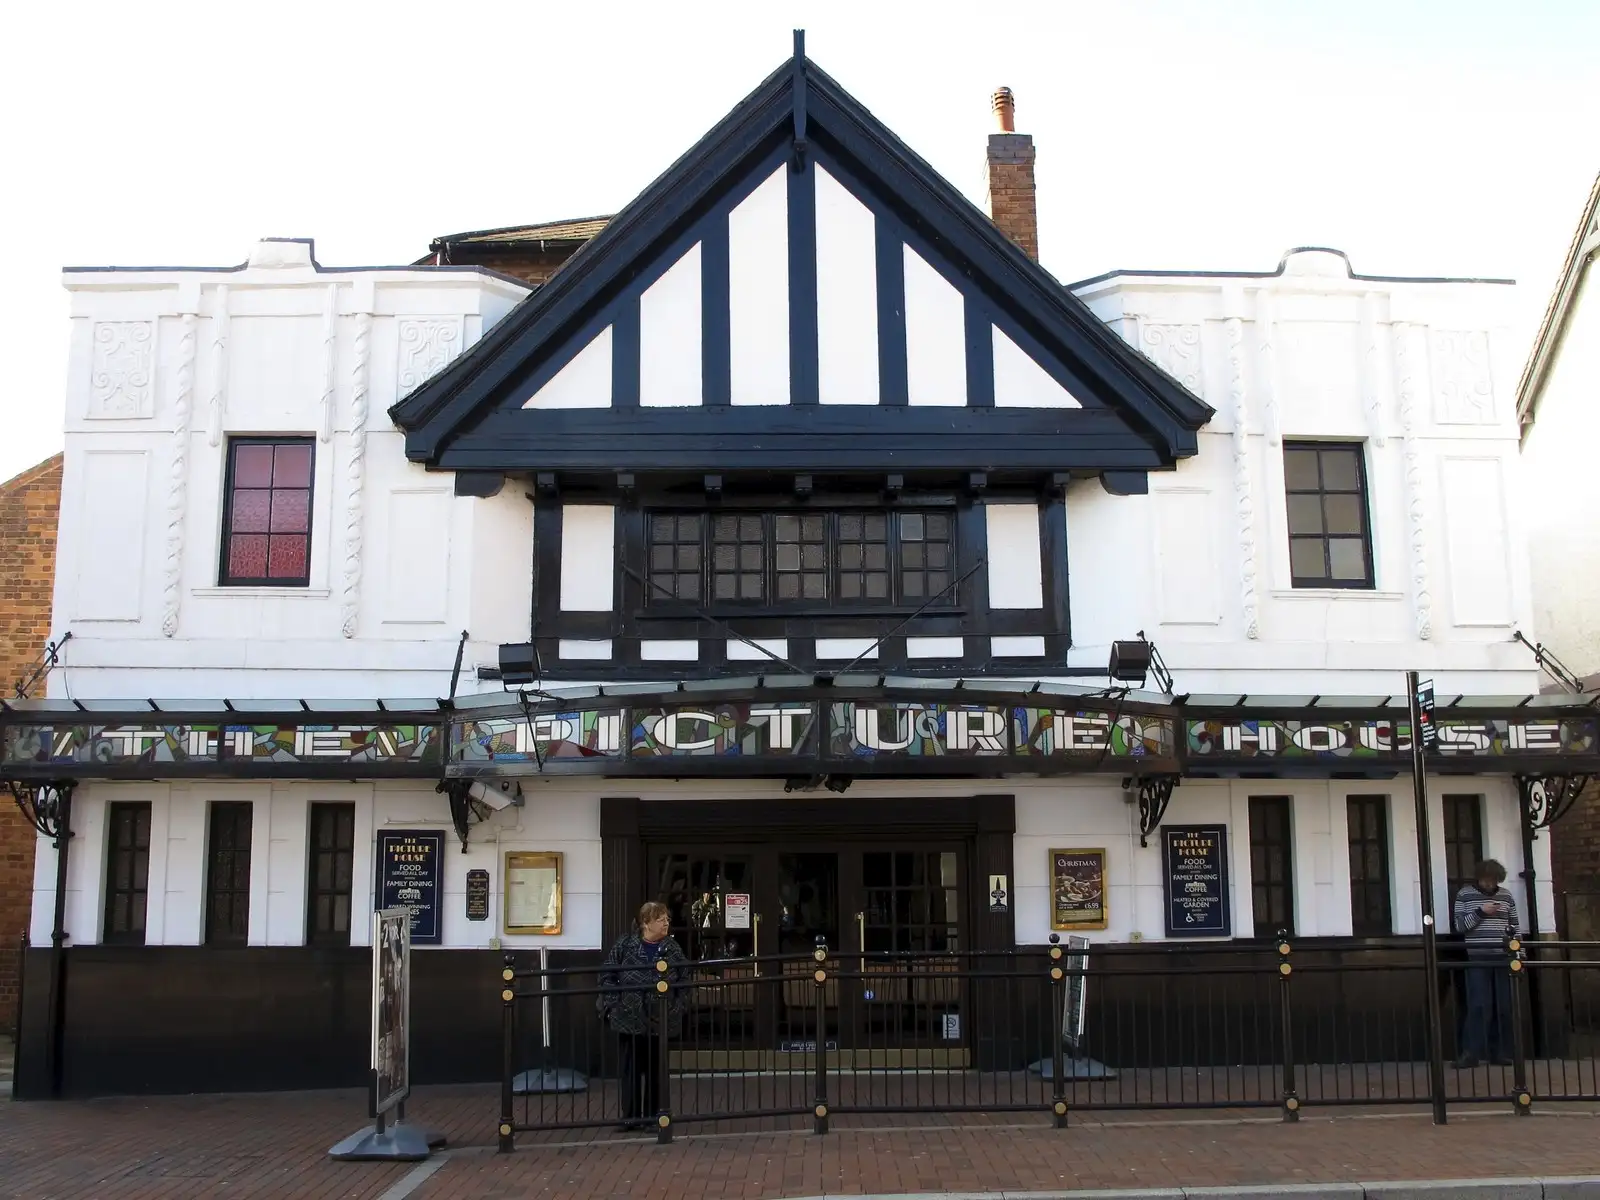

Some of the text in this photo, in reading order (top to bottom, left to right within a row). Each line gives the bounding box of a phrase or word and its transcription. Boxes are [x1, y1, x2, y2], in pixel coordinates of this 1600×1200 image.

[101, 731, 351, 756] THE
[515, 709, 1110, 753] PICTURE
[1223, 724, 1560, 751] HOUSE
